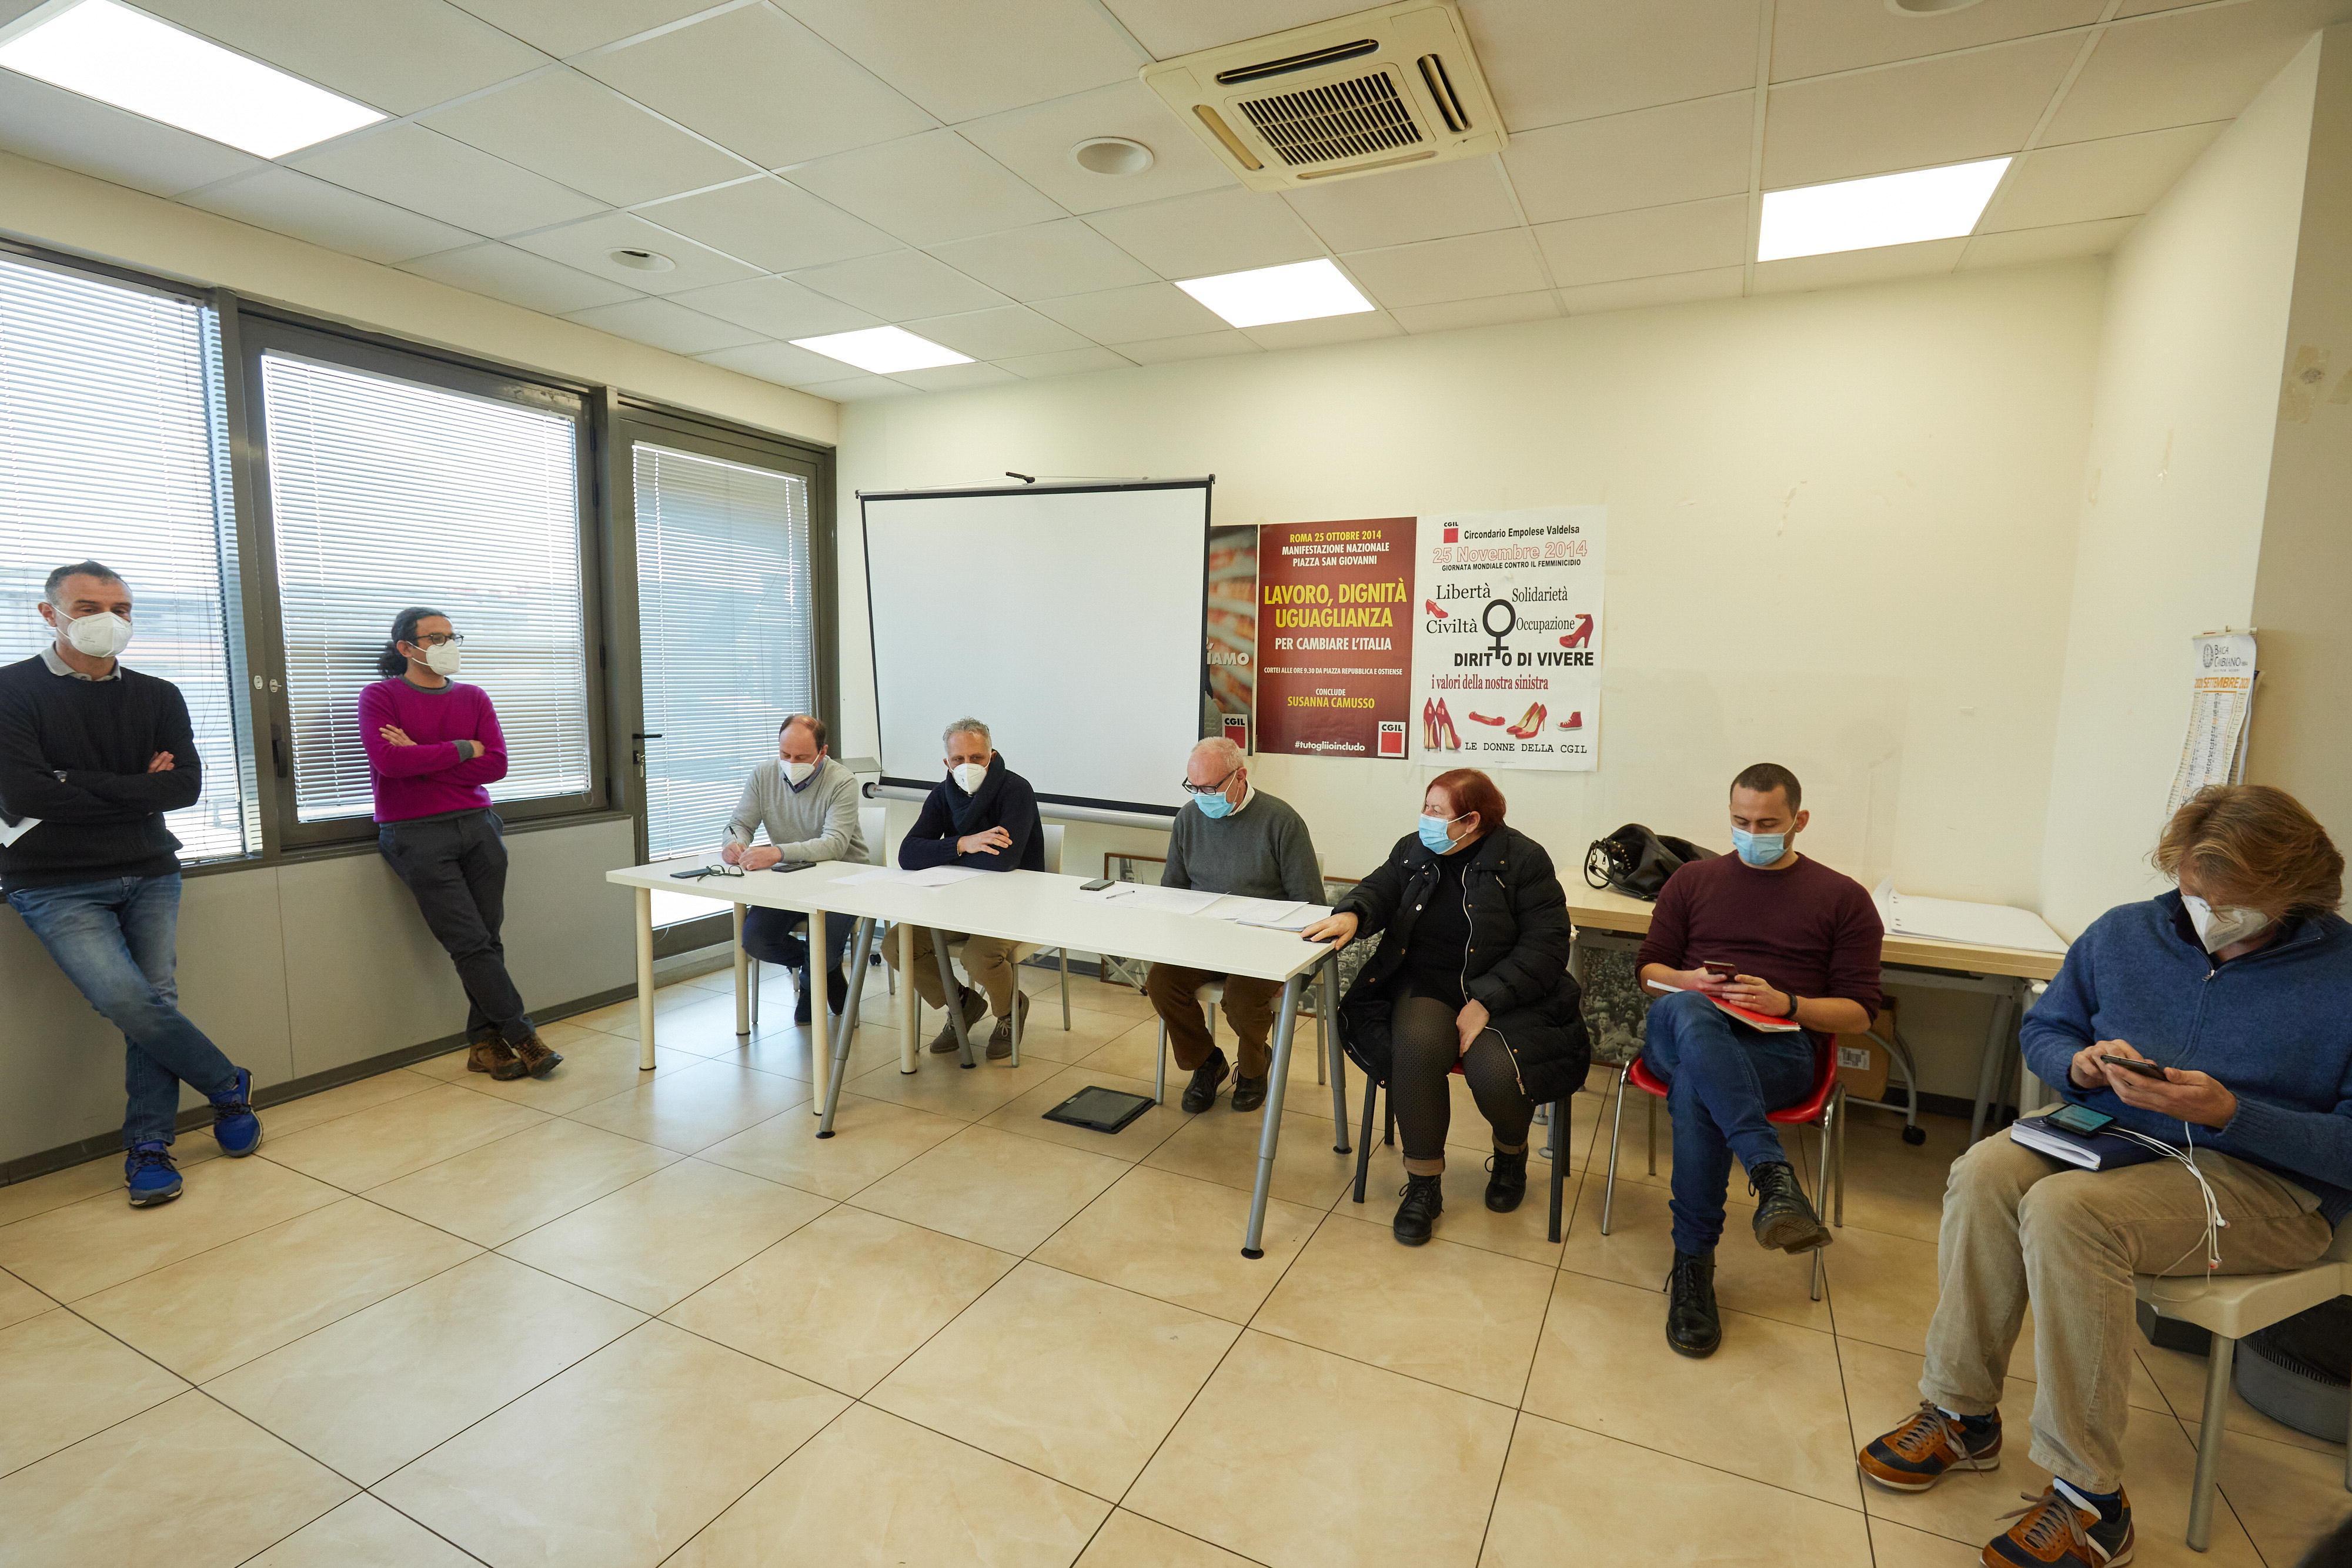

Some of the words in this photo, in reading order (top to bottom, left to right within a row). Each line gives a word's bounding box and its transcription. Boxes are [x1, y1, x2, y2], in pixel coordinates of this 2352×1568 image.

[1289, 533, 1312, 543] ROMA
[1314, 533, 1324, 541] 25
[1326, 531, 1359, 541] OTTOBRE
[1362, 530, 1382, 540] 2014
[1464, 529, 1506, 540] Circondario
[1508, 527, 1544, 539] Empolese
[1546, 524, 1580, 535] Valdelsa
[1282, 544, 1344, 555] MANIFESTAZIONE
[1346, 542, 1389, 553] NAZIONALE
[1432, 547, 1452, 564] 25
[1456, 544, 1540, 563] Novembre
[1544, 540, 1588, 559] 2014
[1292, 557, 1320, 567] PIAZZA
[1322, 557, 1337, 566] SAN
[1339, 555, 1377, 566] GIOVANNI
[1504, 561, 1529, 569] CONTRO
[1538, 559, 1581, 567] FEMMINICIDIO
[1264, 584, 1334, 607] LAVORO,
[1338, 577, 1407, 603] DIGNITÀ
[1436, 583, 1491, 600] Libertà
[1512, 586, 1568, 603] Solidarietà
[1275, 607, 1394, 628] UGUAGLIANZA
[1516, 616, 1575, 634] Occupazione
[1426, 618, 1478, 633] Civiltà
[1275, 637, 1293, 650] PER
[1296, 637, 1349, 650] CAMBIARE
[1352, 637, 1392, 650] L'ITALIA
[1517, 652, 1531, 666] DI
[1537, 651, 1594, 666] VIVERE
[1431, 674, 1435, 689] i
[1436, 674, 1461, 689] valori
[1462, 674, 1483, 689] della
[1485, 676, 1513, 689] nostra
[1515, 674, 1549, 690] sinistra
[1287, 696, 1329, 707] SUSANNA
[1331, 697, 1375, 708] CAMUSSO
[1295, 740, 1365, 751] #tutogliioincludo
[1484, 743, 1515, 751] DONNE
[1521, 744, 1554, 753] DELLA
[1560, 745, 1587, 753] CGIL
